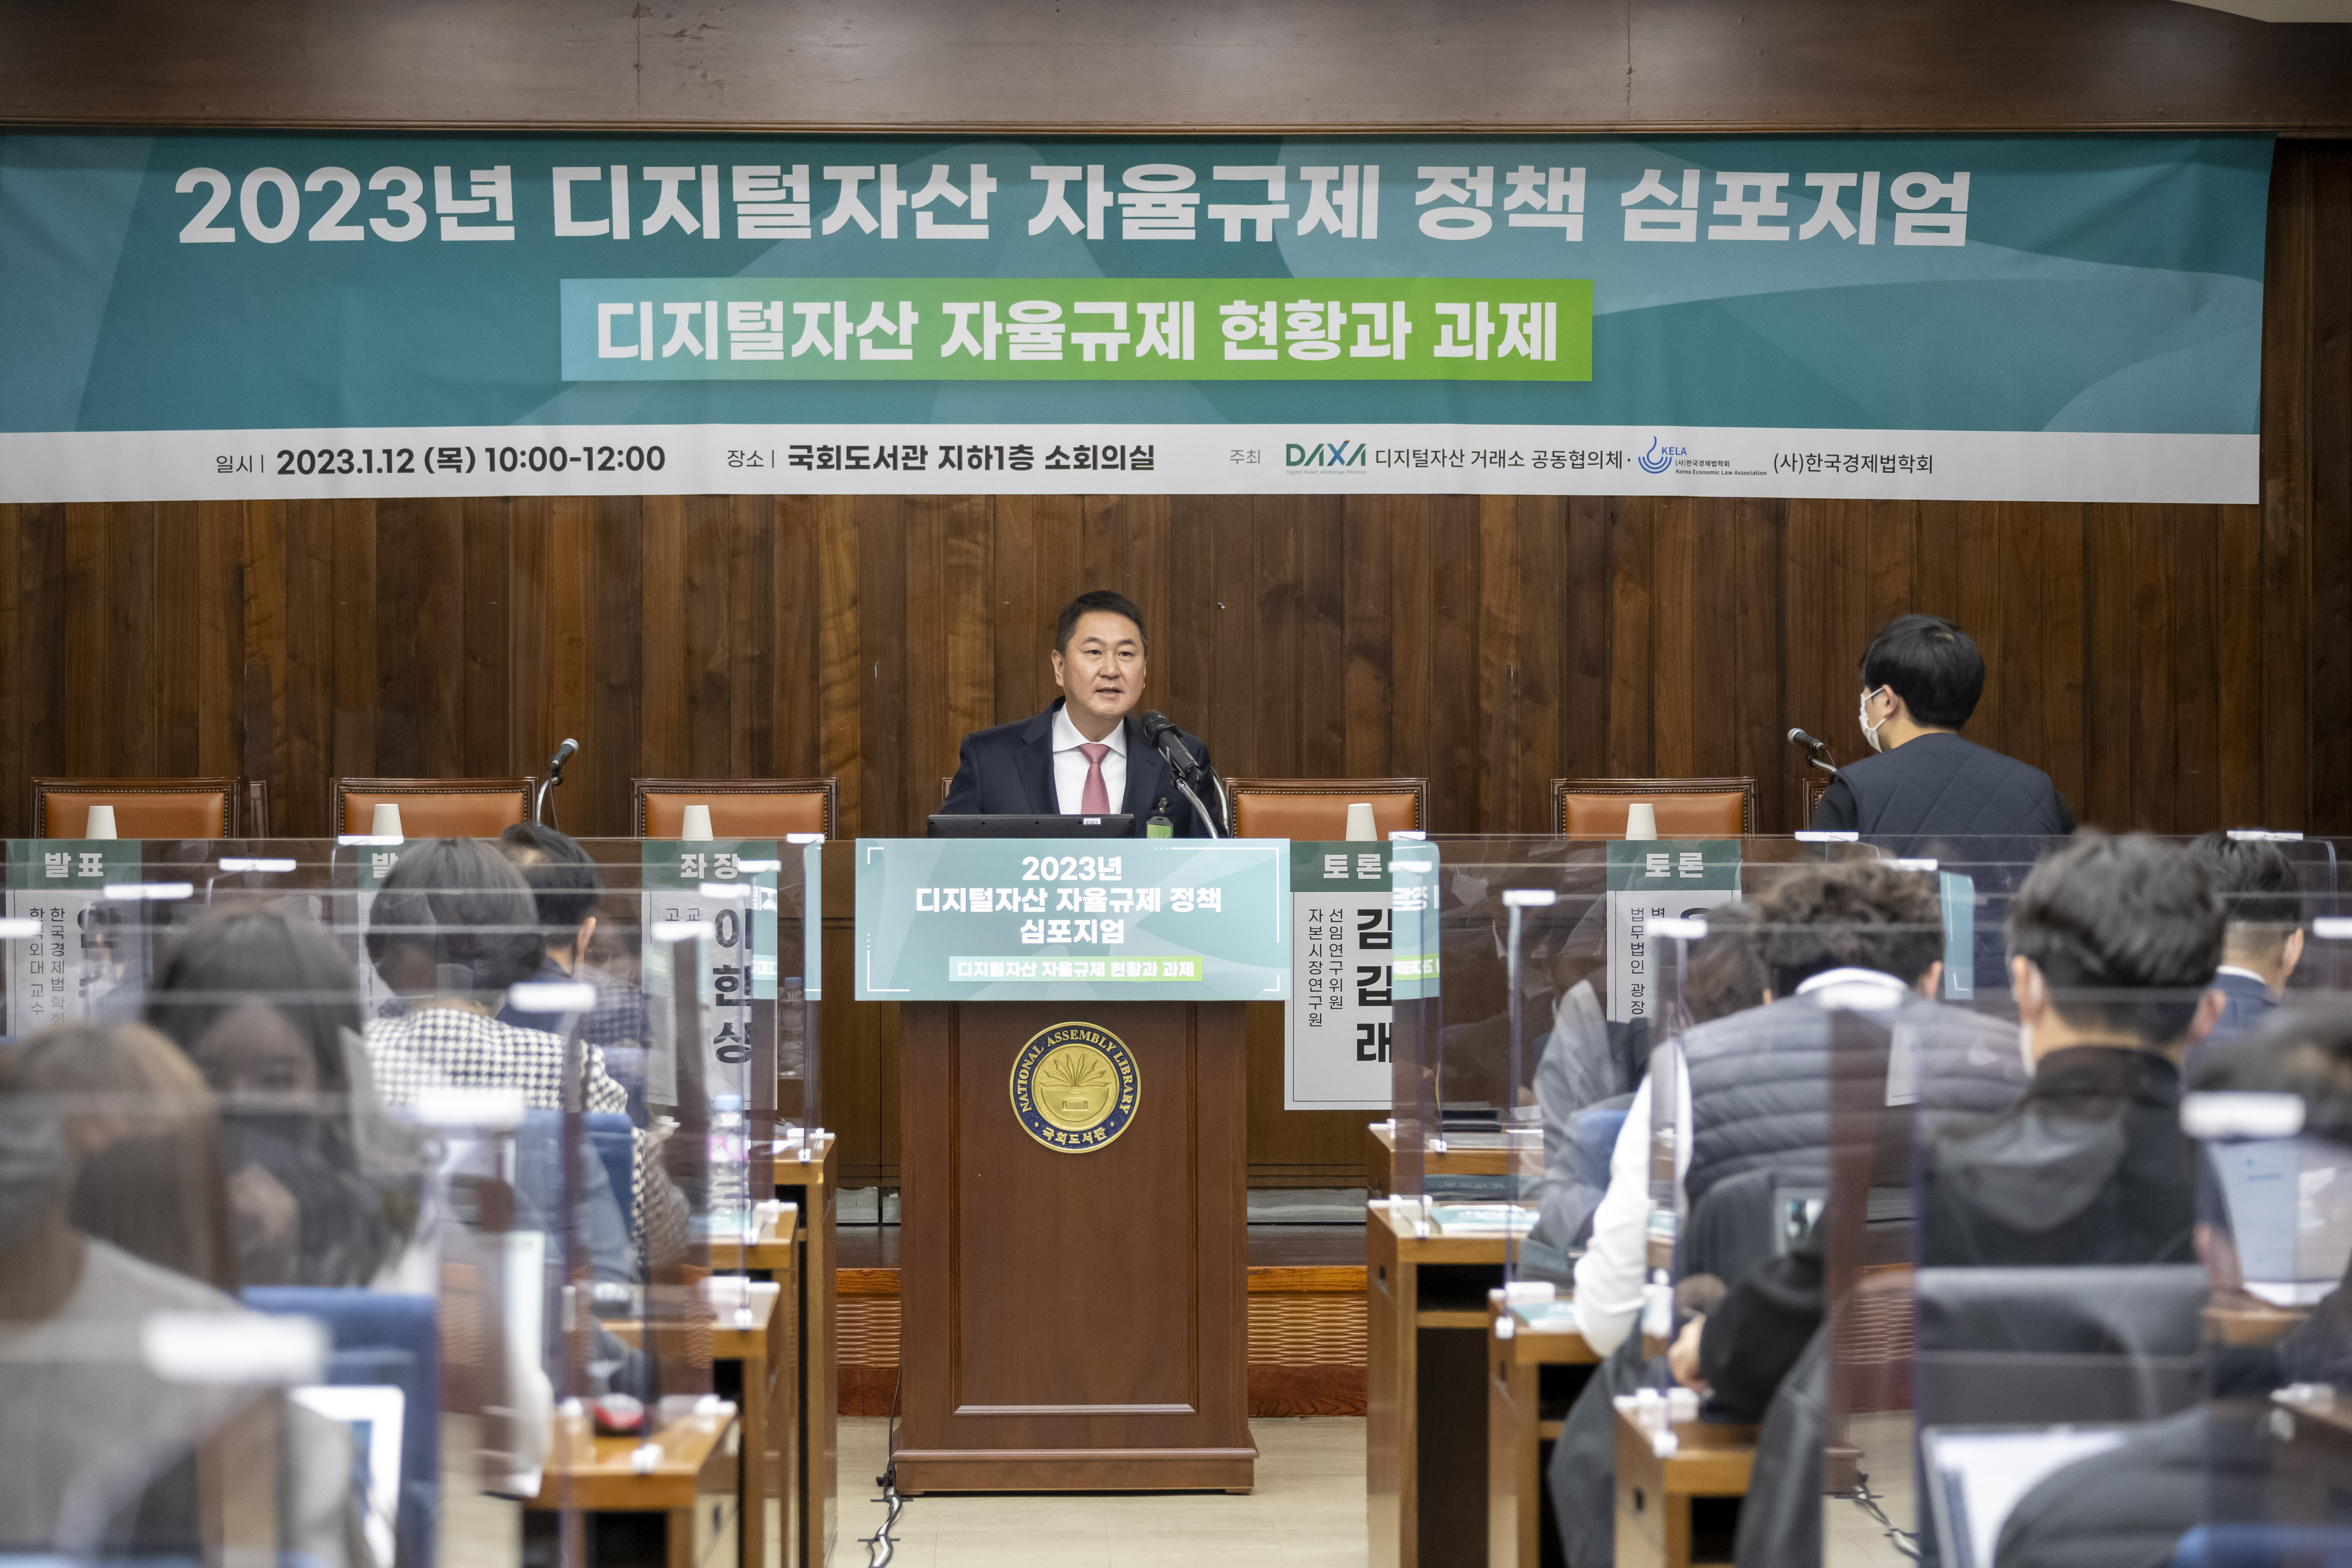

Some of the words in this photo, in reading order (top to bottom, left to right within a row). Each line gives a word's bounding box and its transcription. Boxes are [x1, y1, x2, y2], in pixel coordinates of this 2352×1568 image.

[175, 166, 515, 243] 2023년
[553, 164, 997, 239] 디지털자산
[1028, 164, 1379, 242] 자율규제
[1415, 166, 1585, 241] 정책
[1621, 169, 1970, 246] 심포지엄
[598, 301, 918, 360] 디지털자산
[941, 300, 1194, 361] 자율규제
[1220, 300, 1412, 360] 현황과
[1434, 302, 1556, 361] 과제
[217, 455, 252, 473] 일시
[277, 449, 414, 474] 2023.1.12
[425, 447, 475, 474] (목)
[485, 446, 665, 472] 10:00-12:00
[728, 450, 763, 467] 장소
[789, 445, 928, 470] 국회도서관
[939, 444, 1034, 470] 지하1층
[1045, 445, 1154, 470] 소회의실
[1230, 450, 1260, 465] 주최
[1286, 439, 1367, 466] DAXA
[1376, 449, 1465, 468] 디지털자산
[1471, 450, 1524, 468] 거래소
[1774, 453, 1932, 474] (사)한국경제법학회
[1023, 857, 1122, 880] 2023년
[917, 888, 1048, 912] 디지털자산
[1057, 888, 1160, 912] 자율규제
[1171, 888, 1221, 912] 정책
[29, 907, 45, 974] 한외대
[1021, 919, 1124, 944] 심포지엄
[1631, 907, 1645, 974] 법무법인
[958, 962, 1037, 977] 디지털자산
[1042, 962, 1105, 977] 자율규제
[1110, 961, 1158, 977] 현황과
[1163, 962, 1193, 977] 과제
[1308, 909, 1323, 1027] 자본시장연구원
[1329, 909, 1344, 1010] 선임연구위원
[30, 984, 44, 1015] 교수
[1631, 983, 1645, 1015] 광장
[1018, 1045, 1045, 1113] NATIONAL
[1046, 1030, 1117, 1053] ASSEMBLY
[1113, 1051, 1133, 1114] LIBRARY
[1043, 1127, 1107, 1146] 국회도서관
